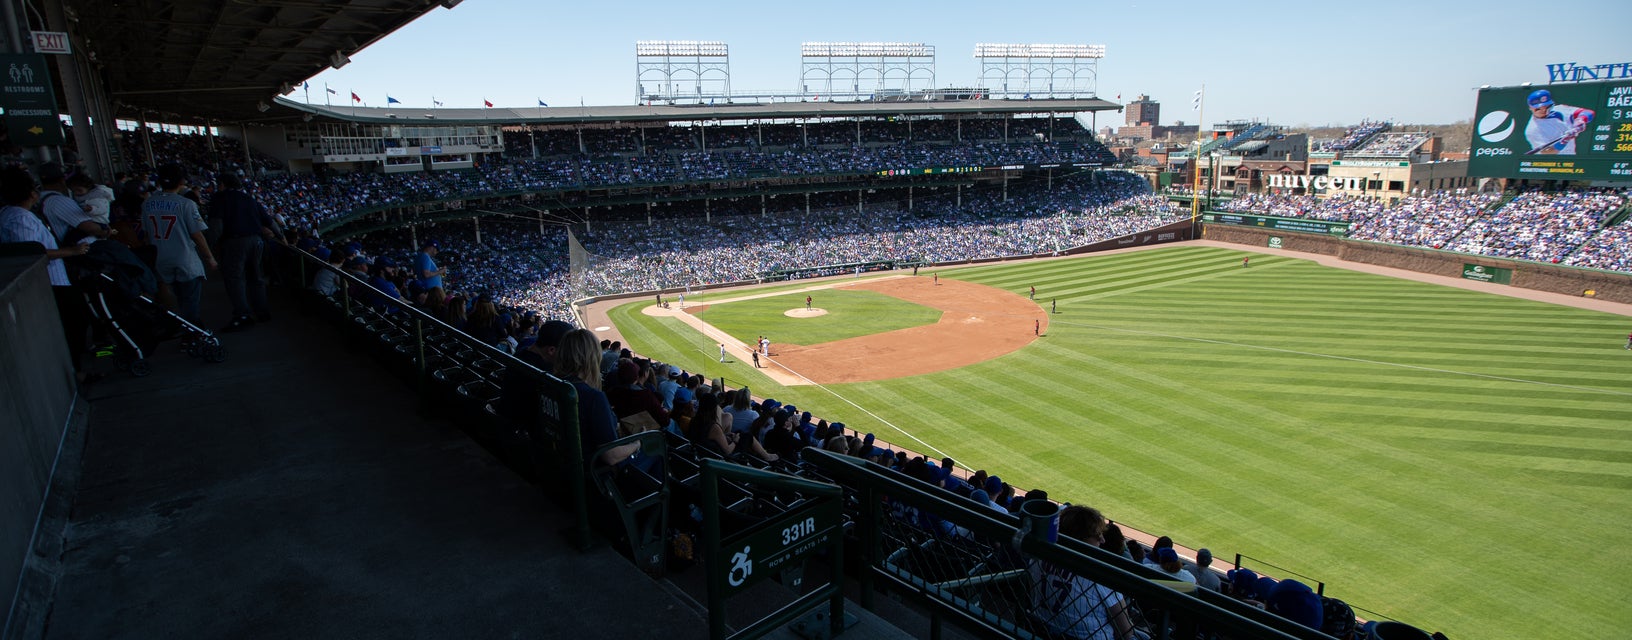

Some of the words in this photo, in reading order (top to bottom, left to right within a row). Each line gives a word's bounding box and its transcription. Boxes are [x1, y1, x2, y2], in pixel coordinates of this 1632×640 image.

[37, 34, 64, 48] EXIT
[4, 85, 45, 93] RESTROOMS
[8, 108, 52, 116] CONCESSIONS
[1476, 147, 1507, 156] pepsi
[1268, 174, 1361, 190] nuveen
[146, 200, 178, 211] BRYANT
[150, 215, 176, 239] 17
[782, 517, 815, 545] 331R
[769, 558, 784, 568] ROW
[795, 542, 815, 555] SEATS
